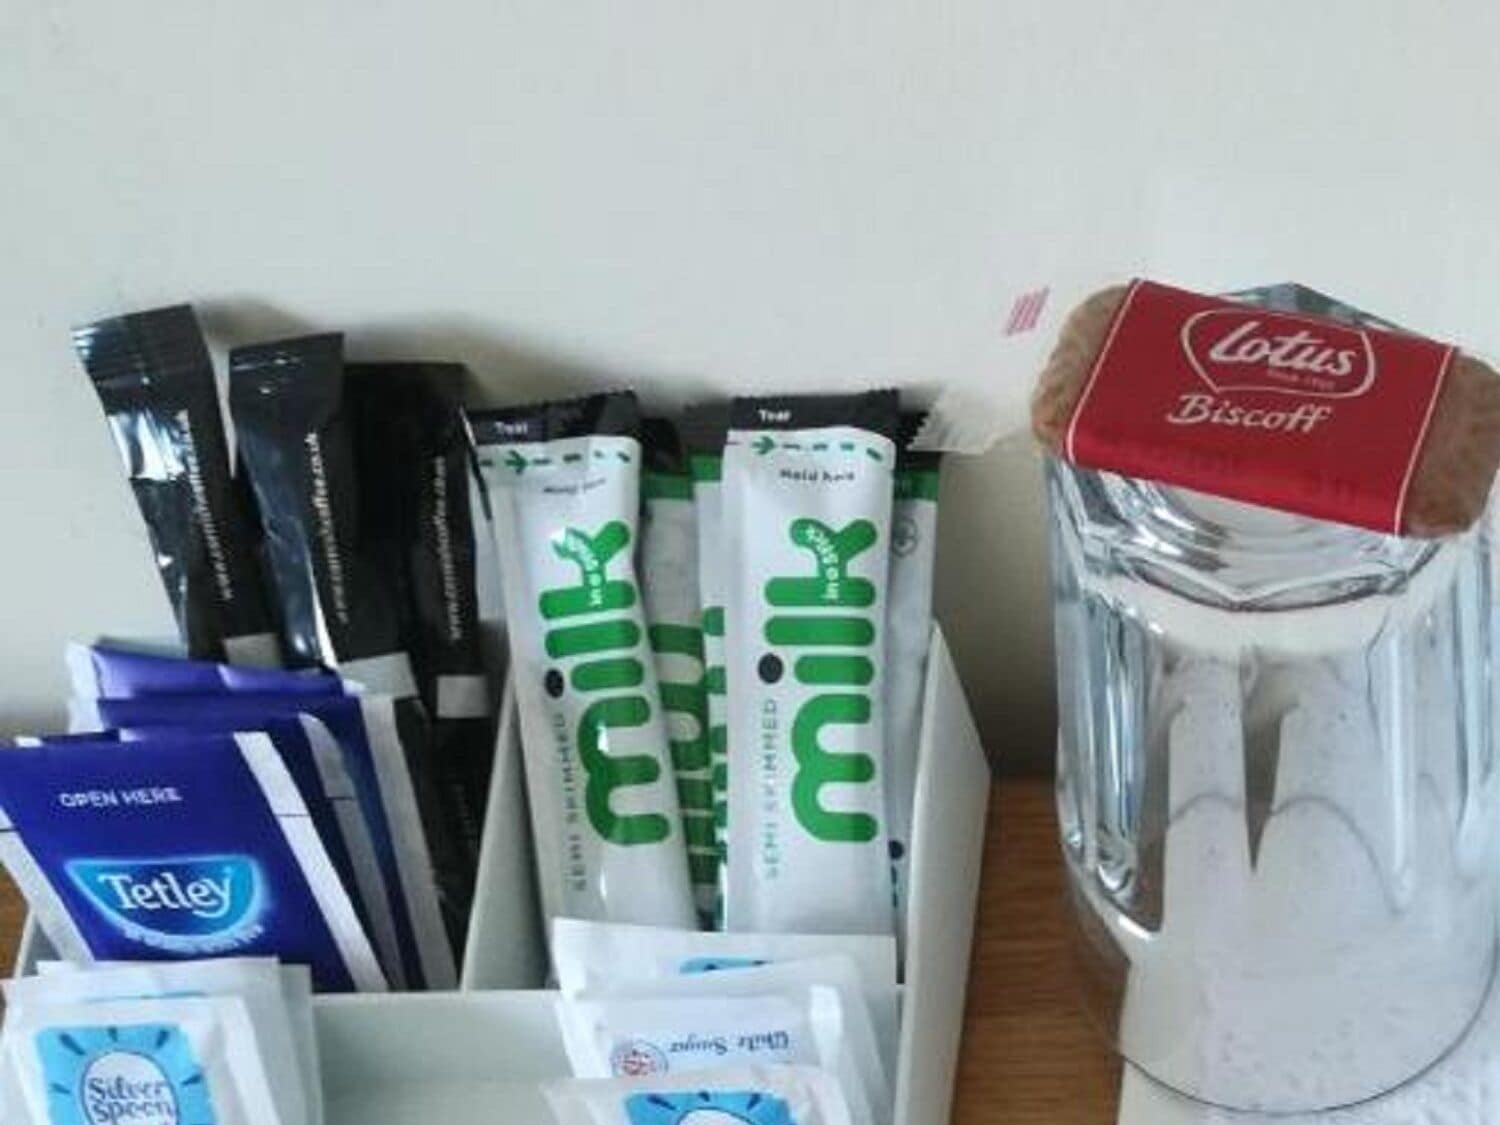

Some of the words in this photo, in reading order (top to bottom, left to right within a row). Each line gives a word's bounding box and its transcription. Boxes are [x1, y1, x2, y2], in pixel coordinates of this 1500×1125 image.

[1208, 321, 1357, 378] Lotus
[1167, 394, 1332, 434] Biscoff
[539, 520, 671, 846] milk
[757, 517, 879, 843] milk
[60, 789, 118, 808] OPEN
[122, 787, 182, 805] HERE
[98, 867, 233, 919] Tetley
[88, 1075, 167, 1101] Silver
